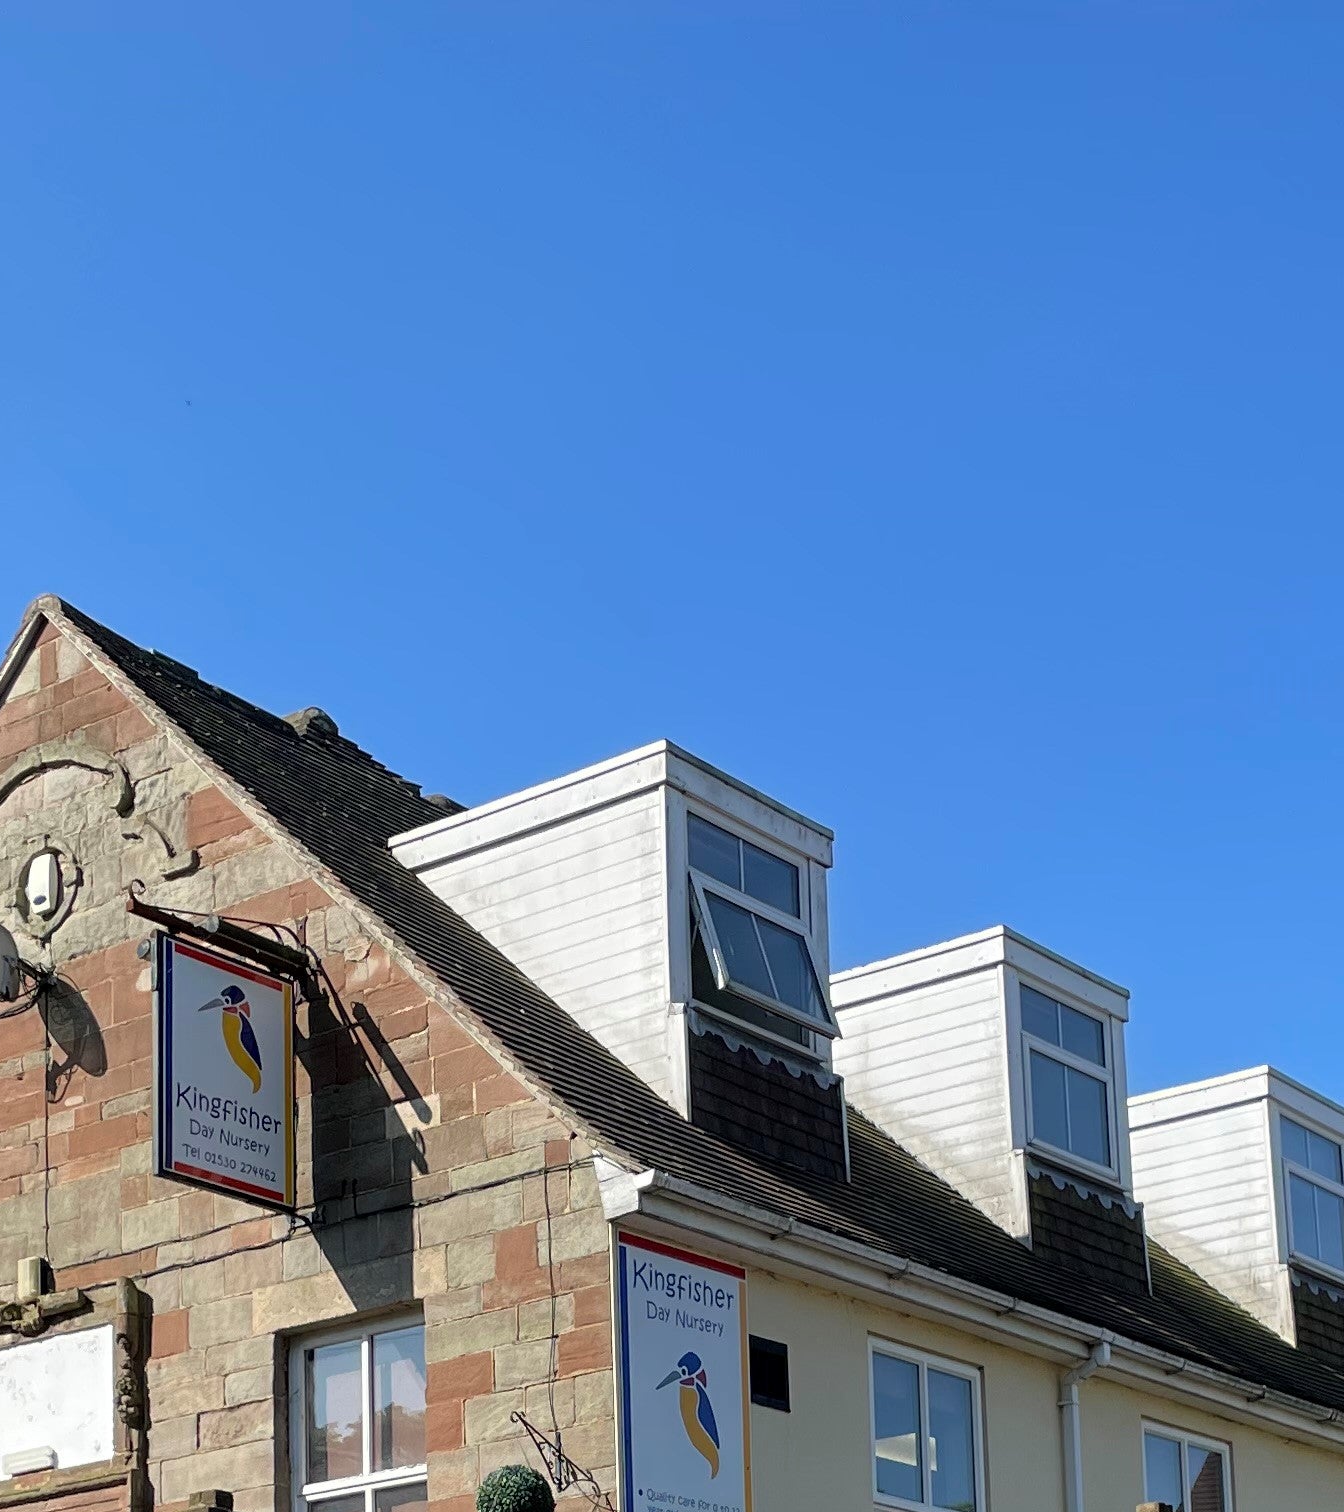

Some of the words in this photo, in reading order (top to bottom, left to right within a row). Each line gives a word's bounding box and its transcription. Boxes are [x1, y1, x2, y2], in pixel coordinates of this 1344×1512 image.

[176, 1082, 282, 1134] Kingfisher
[189, 1118, 214, 1139] Day
[219, 1128, 270, 1157] Nursery
[182, 1143, 200, 1160] Tel
[204, 1151, 236, 1169] 01530
[240, 1162, 277, 1182] 274462
[633, 1259, 734, 1310] Kingfisher
[646, 1300, 670, 1323] Day
[675, 1308, 724, 1337] Nursery
[646, 1488, 676, 1504] Quality
[697, 1499, 711, 1511] for
